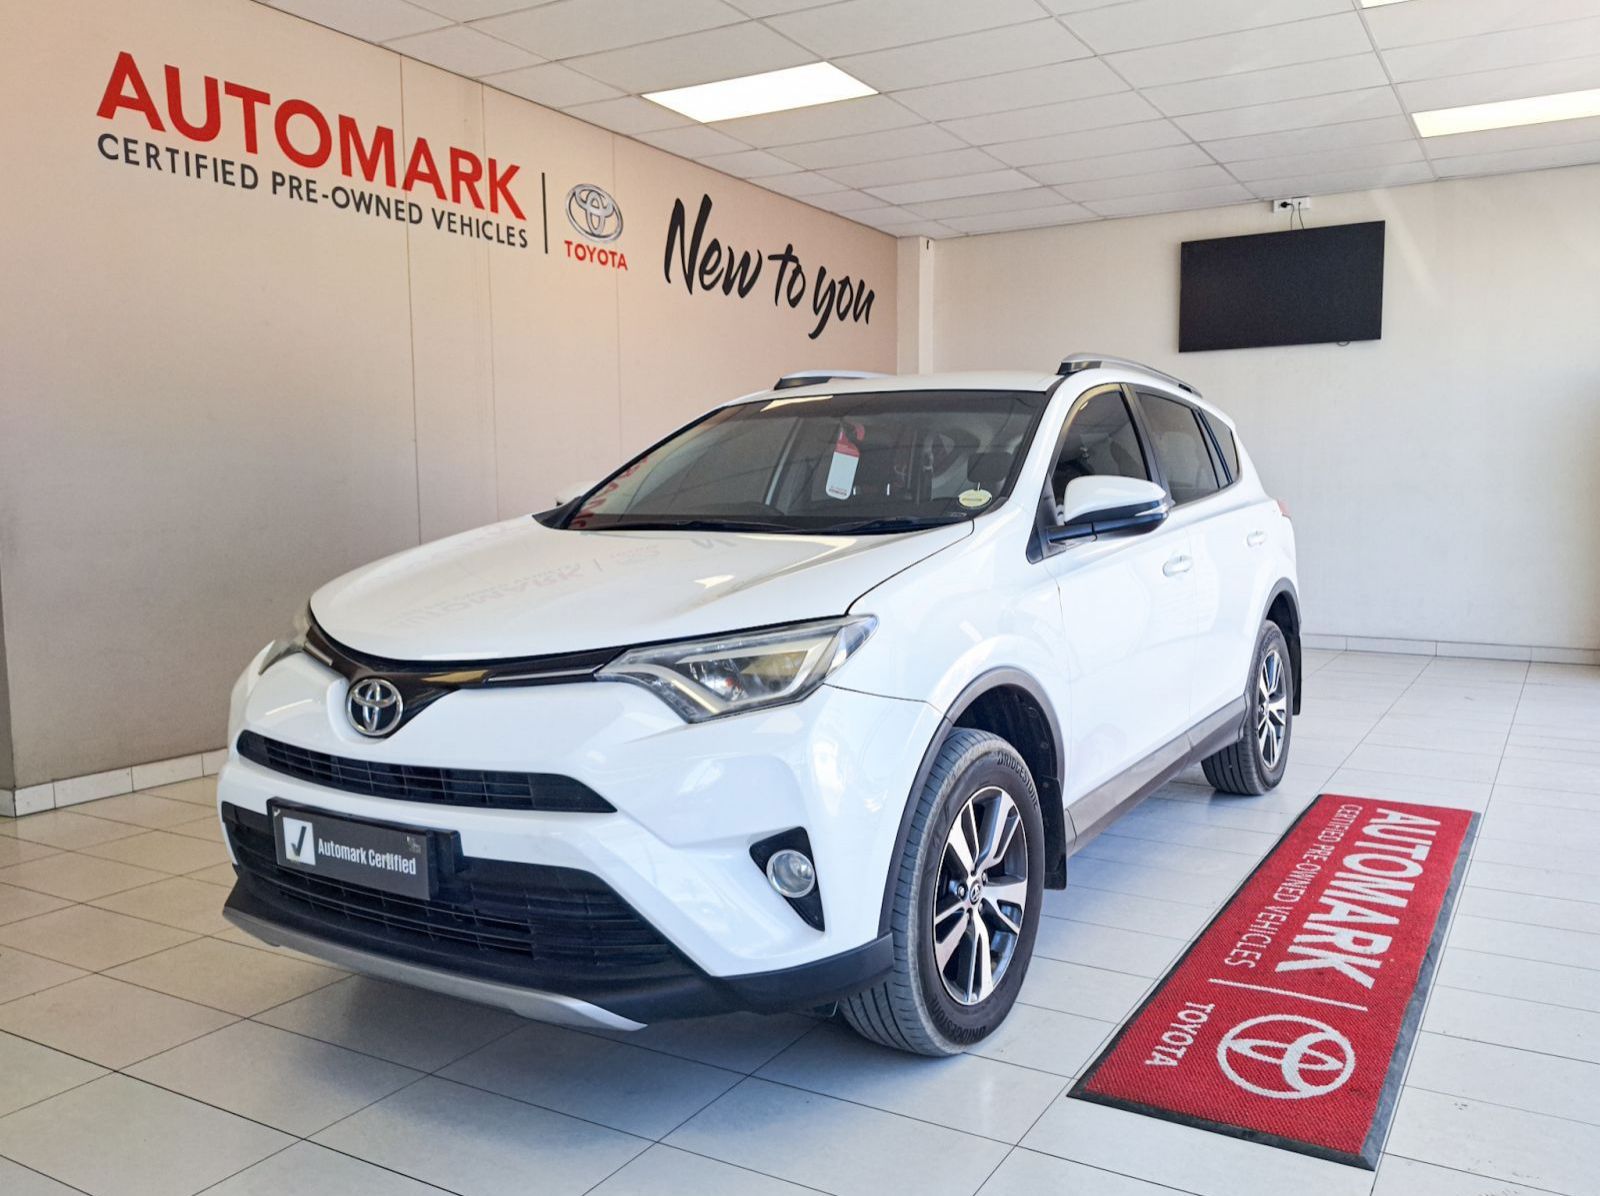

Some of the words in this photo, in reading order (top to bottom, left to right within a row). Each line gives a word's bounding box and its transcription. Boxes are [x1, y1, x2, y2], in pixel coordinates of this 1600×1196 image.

[96, 50, 527, 221] AUTOMARK
[97, 132, 258, 190] CERTIFIED
[271, 170, 423, 225] PRE-OWNED
[431, 207, 528, 248] VEHICLES
[564, 239, 628, 271] TOYOTA
[664, 193, 763, 298] New
[767, 243, 806, 308] to
[808, 265, 875, 340] you
[1317, 803, 1363, 843] CERTIFIED
[318, 837, 368, 866] Automark
[368, 848, 417, 876] Certified
[1272, 843, 1335, 903] PRE-OWNED
[1274, 807, 1441, 990] AUTOMARK
[1224, 905, 1294, 969] VEHICLES
[1144, 1001, 1216, 1068] TOYOTA
